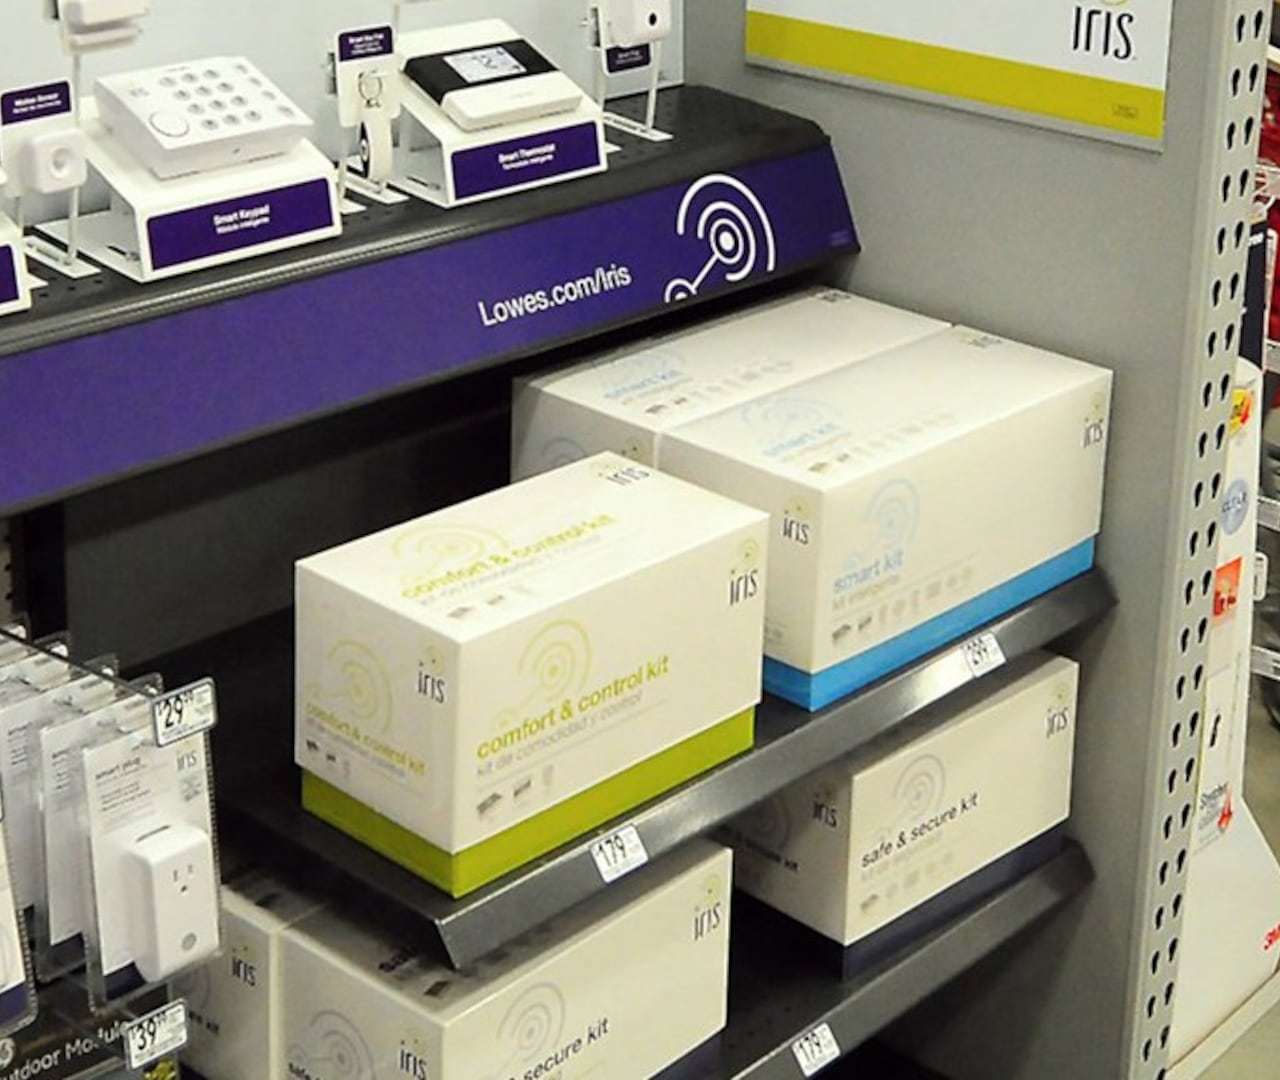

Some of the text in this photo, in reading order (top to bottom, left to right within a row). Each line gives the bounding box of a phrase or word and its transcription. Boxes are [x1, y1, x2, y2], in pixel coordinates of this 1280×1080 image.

[478, 264, 631, 325] Lowes.com/Iris
[833, 549, 903, 594] smart kit
[477, 656, 668, 759] comfort & control kit
[862, 793, 977, 867] safe & secure kit
[524, 1019, 608, 1080] secure kit
